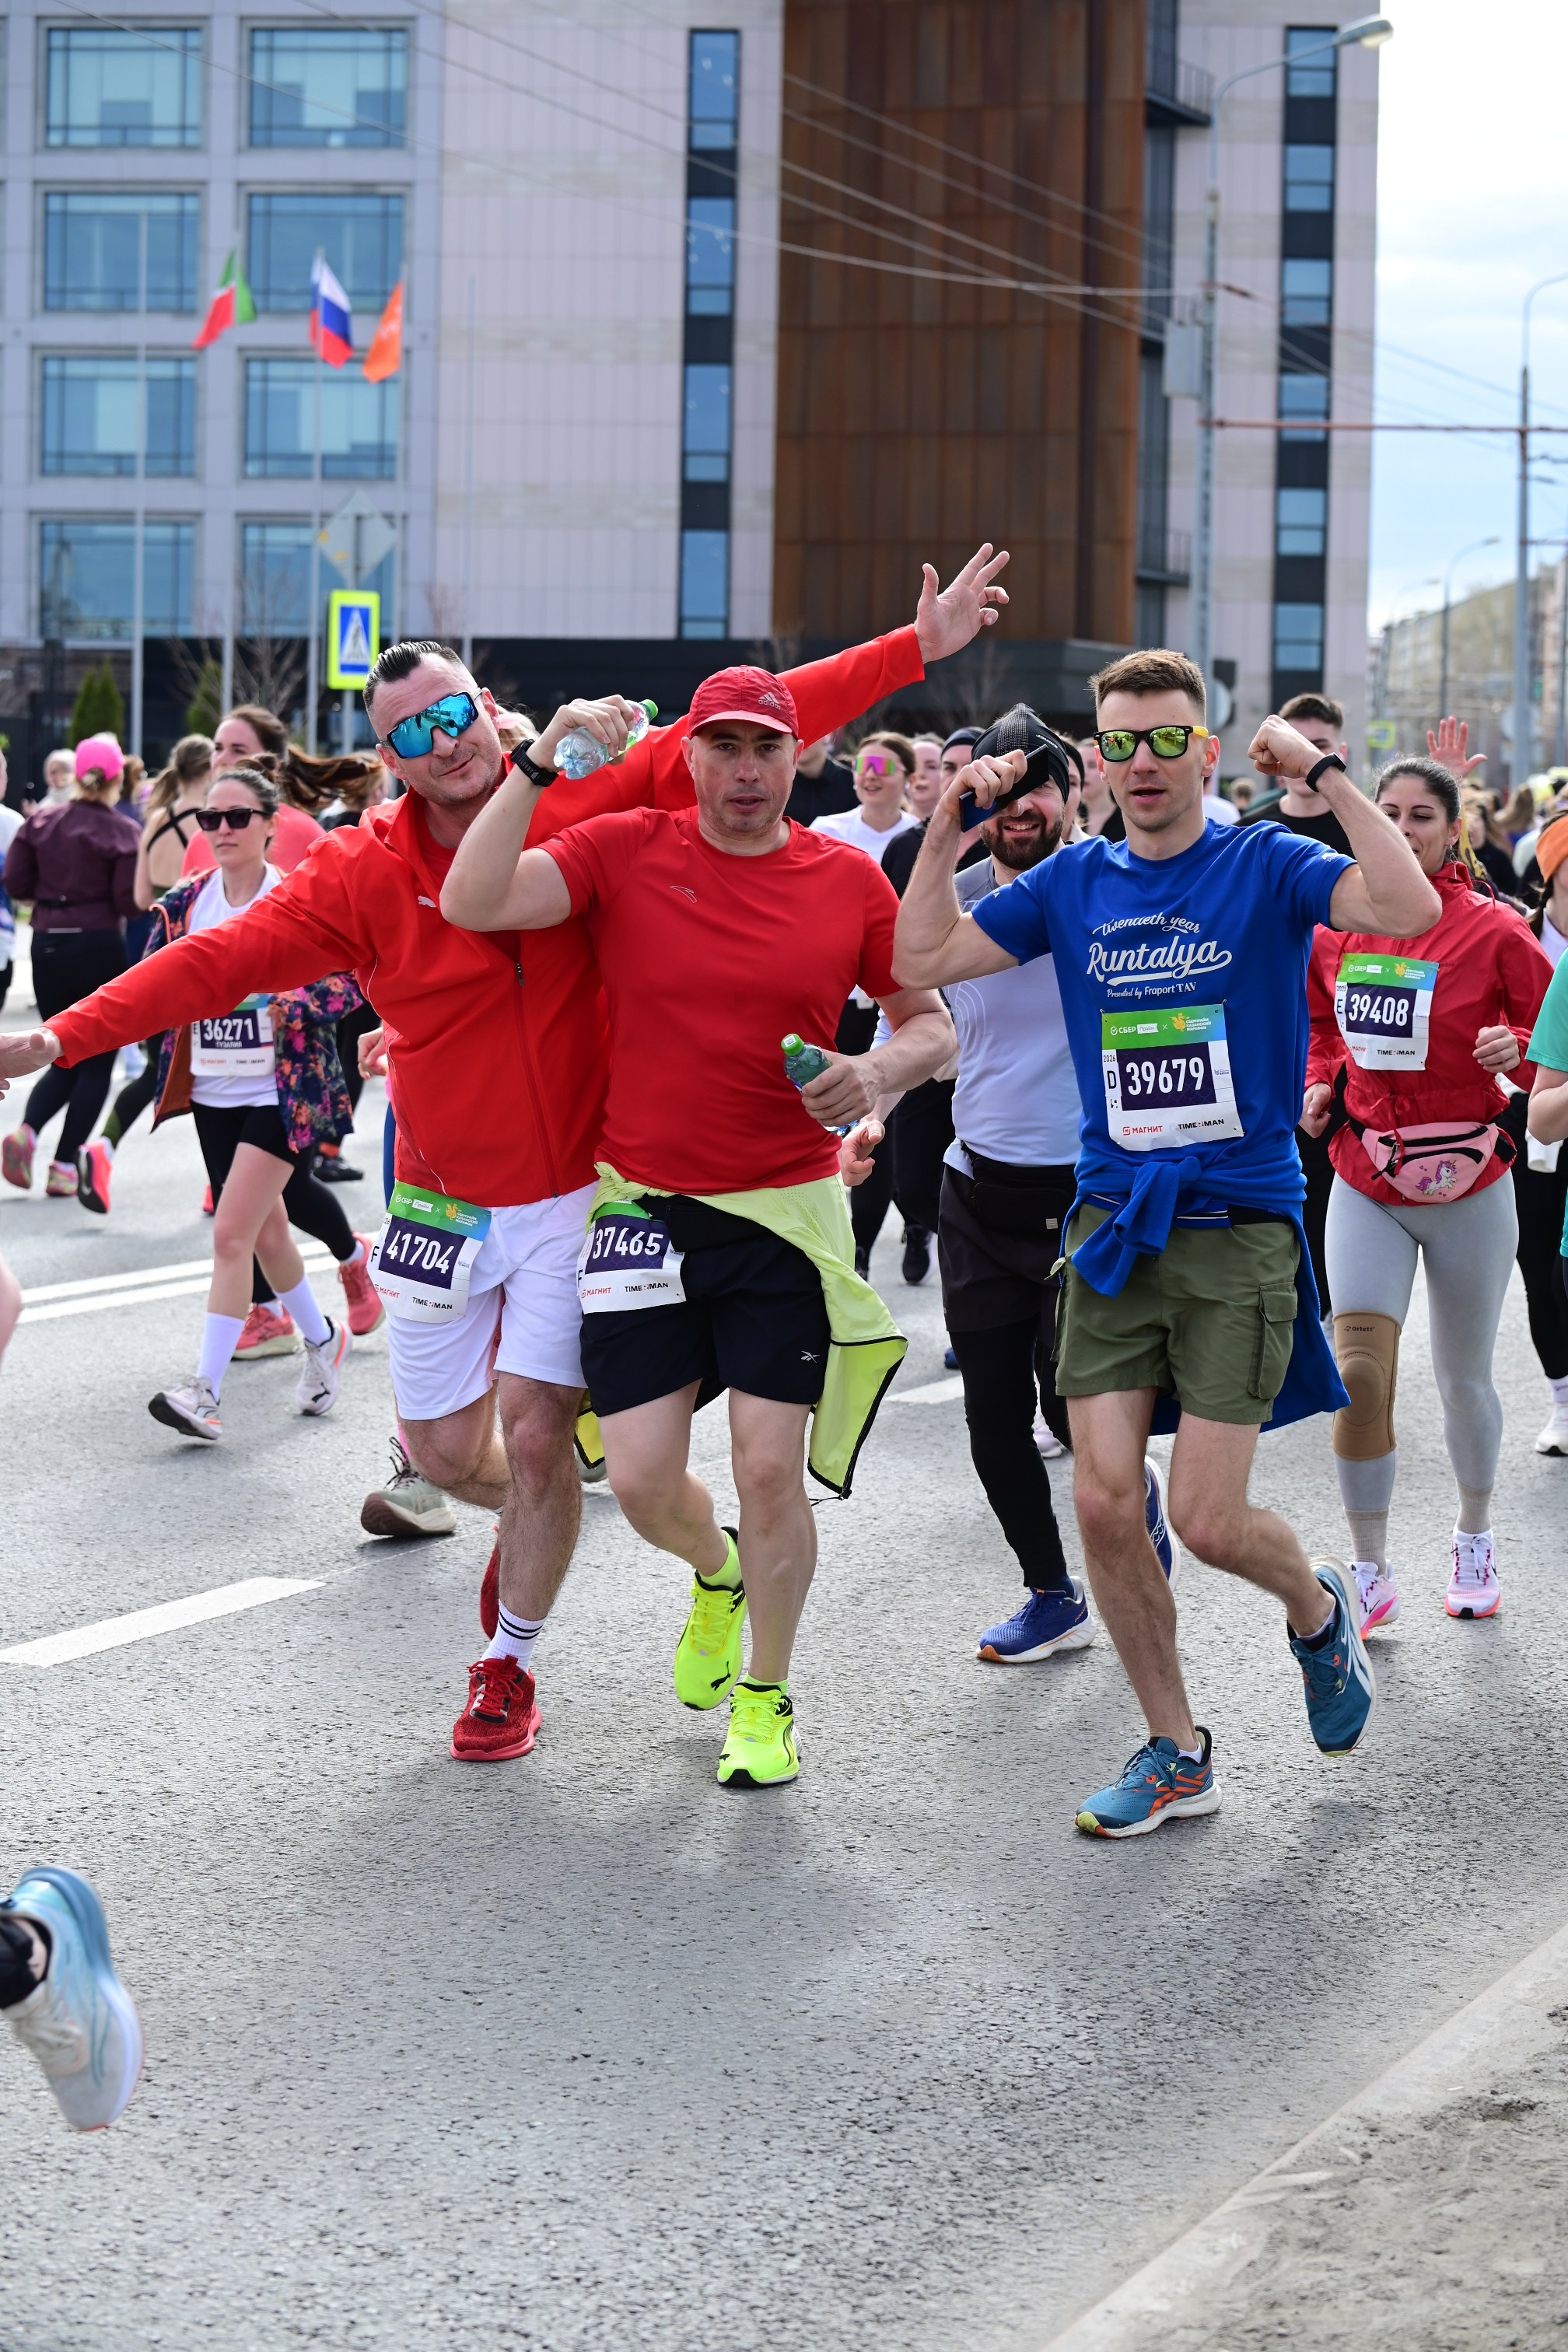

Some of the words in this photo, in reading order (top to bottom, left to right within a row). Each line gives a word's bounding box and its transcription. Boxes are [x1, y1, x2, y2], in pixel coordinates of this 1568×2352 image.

[758, 700, 780, 709] adidas
[1092, 912, 1167, 936] twentieth
[1162, 916, 1200, 933] year
[1087, 936, 1232, 983] Runtalya
[1107, 988, 1132, 998] Presented
[1134, 988, 1143, 999] by
[1144, 985, 1175, 996] Fraport
[1176, 982, 1196, 992] TAV
[1337, 999, 1343, 1013] E
[1348, 993, 1409, 1027] 39408
[203, 1017, 254, 1041] 36271
[1107, 1070, 1117, 1089] D
[1125, 1057, 1205, 1096] 39679
[1132, 1125, 1163, 1134] МАГНИТ
[386, 1230, 455, 1274] 41704
[592, 1226, 664, 1259] 37465
[370, 1245, 380, 1262] F
[380, 1287, 400, 1299] МАГНИТ
